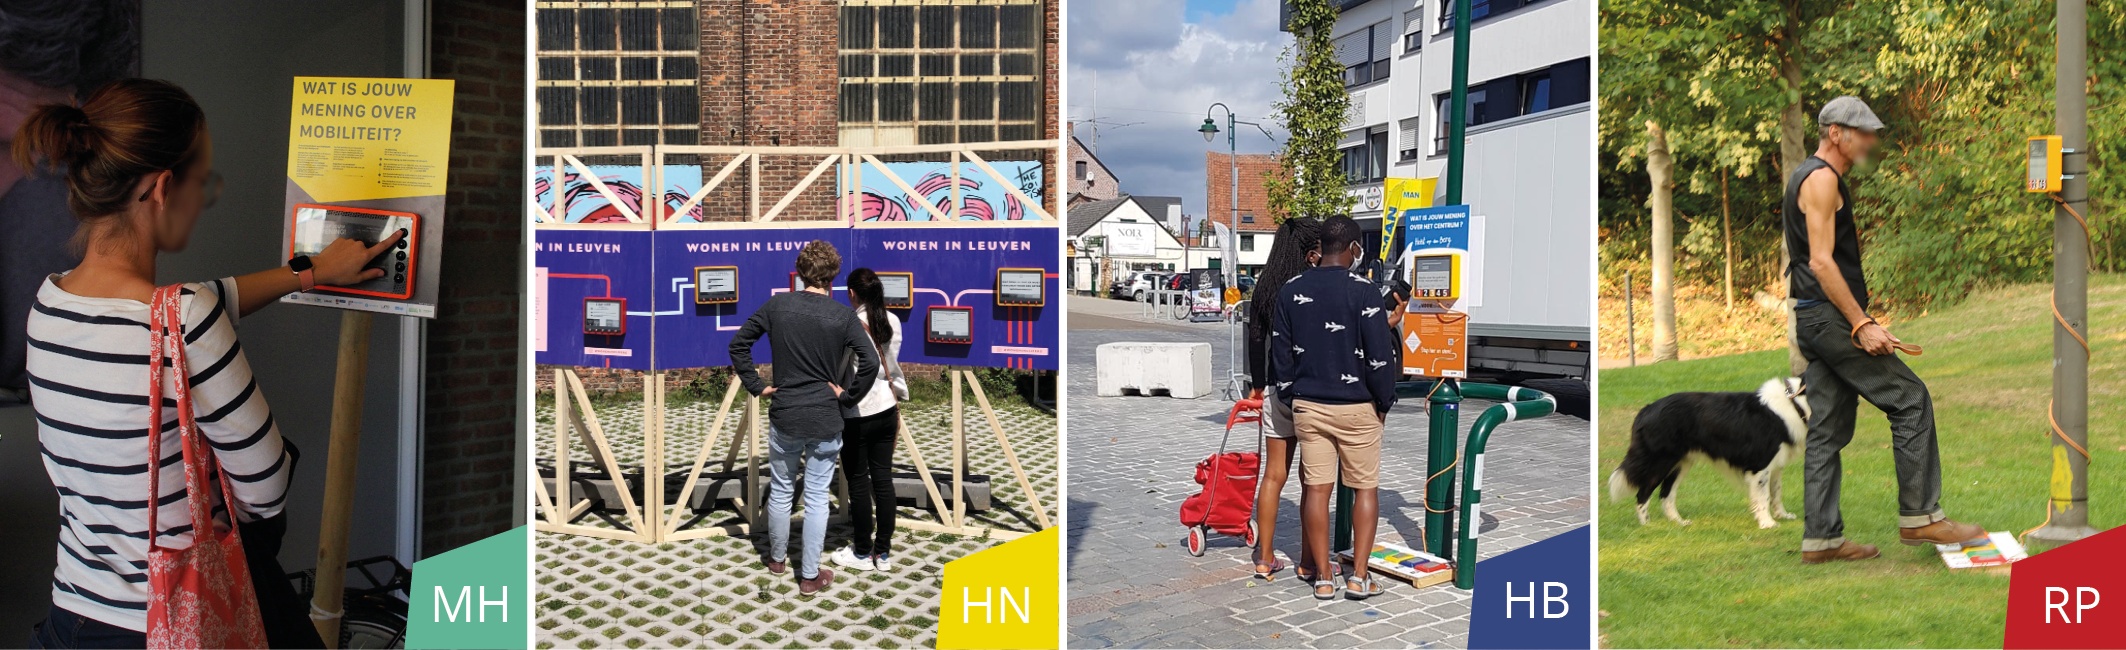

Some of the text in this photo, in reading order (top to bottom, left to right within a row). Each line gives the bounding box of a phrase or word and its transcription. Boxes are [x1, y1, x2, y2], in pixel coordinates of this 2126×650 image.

[302, 81, 412, 97] WAT IS JOUW
[301, 103, 417, 120] MENING OVER
[299, 124, 402, 142] MOBILITEIT?
[1403, 191, 1420, 199] MAN
[1428, 213, 1444, 221] JOUW
[1444, 212, 1466, 220] MENING
[1382, 206, 1398, 253] MAN
[1434, 221, 1459, 229] CENTRUM
[1118, 228, 1142, 238] NOIR
[549, 242, 563, 252] IN
[568, 243, 621, 254] LEUVEN
[686, 242, 740, 253] WONEN
[746, 242, 761, 252] IN
[883, 240, 1031, 251] WONEN IN LEUVEN
